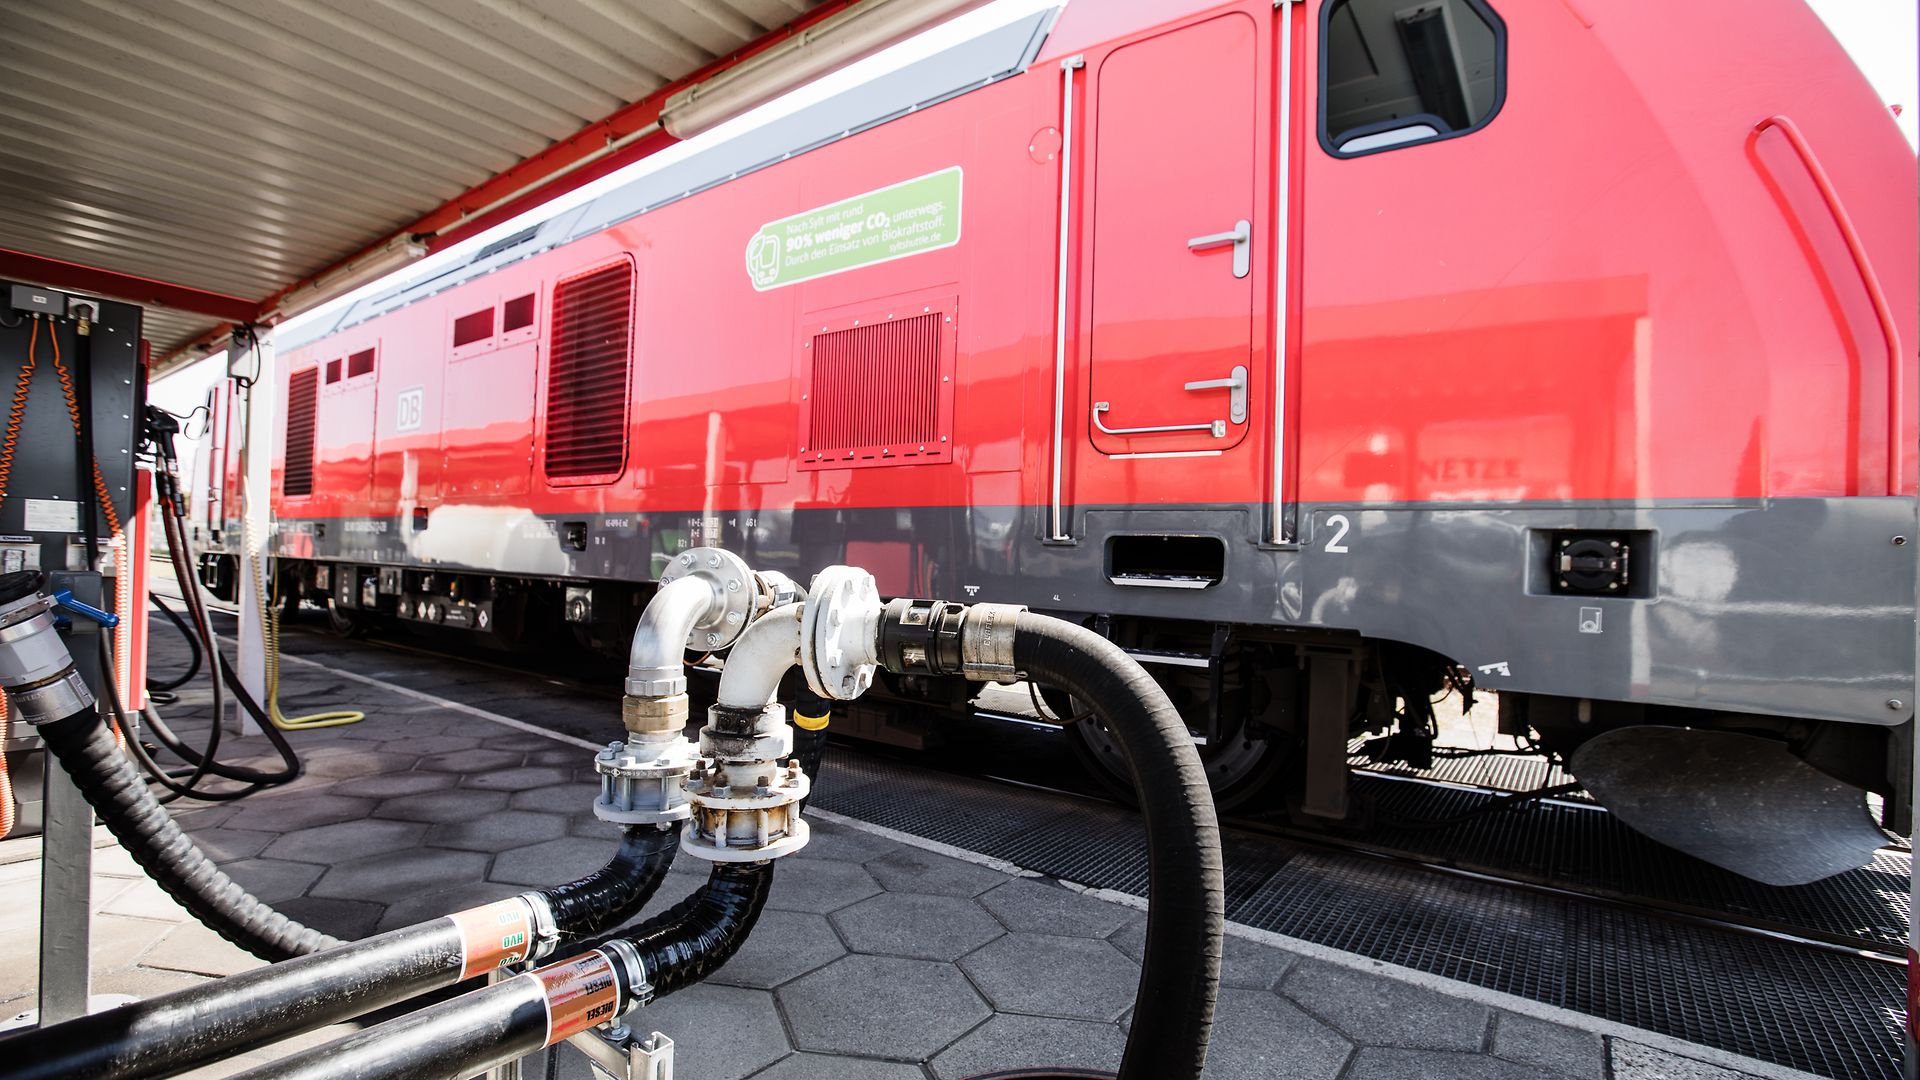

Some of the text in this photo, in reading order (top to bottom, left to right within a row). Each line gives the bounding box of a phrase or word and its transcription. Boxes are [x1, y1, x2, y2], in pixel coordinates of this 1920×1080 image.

[786, 233, 813, 253] 90%
[815, 220, 864, 244] weniger
[892, 201, 946, 223] unterwegs.
[787, 203, 864, 236] Nach Sylt mit rund
[785, 214, 945, 267] Durch den Einsatz von Biokraftstoff.
[399, 393, 421, 428] DB
[1325, 514, 1350, 553] 2
[503, 932, 523, 948] HVO
[586, 1000, 614, 1021] DIESEL
